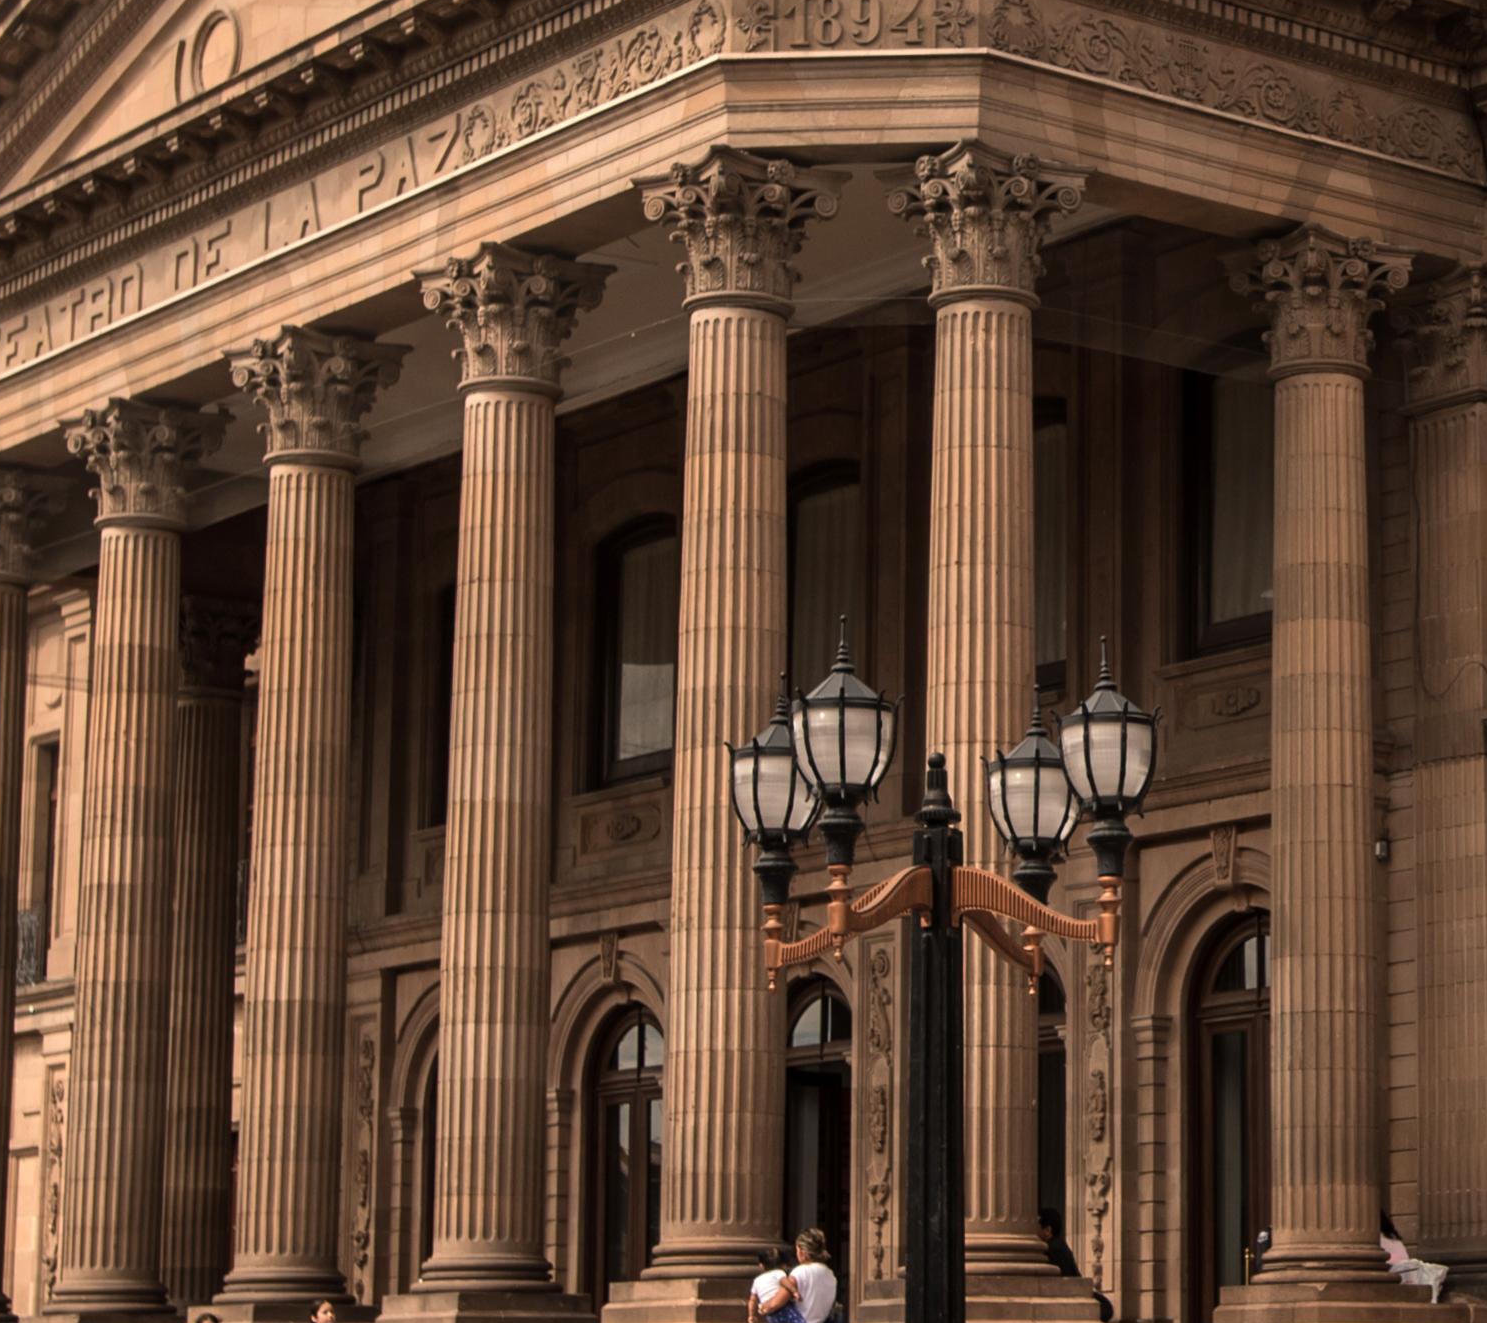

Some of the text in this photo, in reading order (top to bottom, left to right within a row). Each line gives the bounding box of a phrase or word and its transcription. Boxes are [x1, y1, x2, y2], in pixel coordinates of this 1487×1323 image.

[172, 219, 233, 293] DE
[261, 179, 322, 251] LA
[356, 111, 463, 214] PAZ
